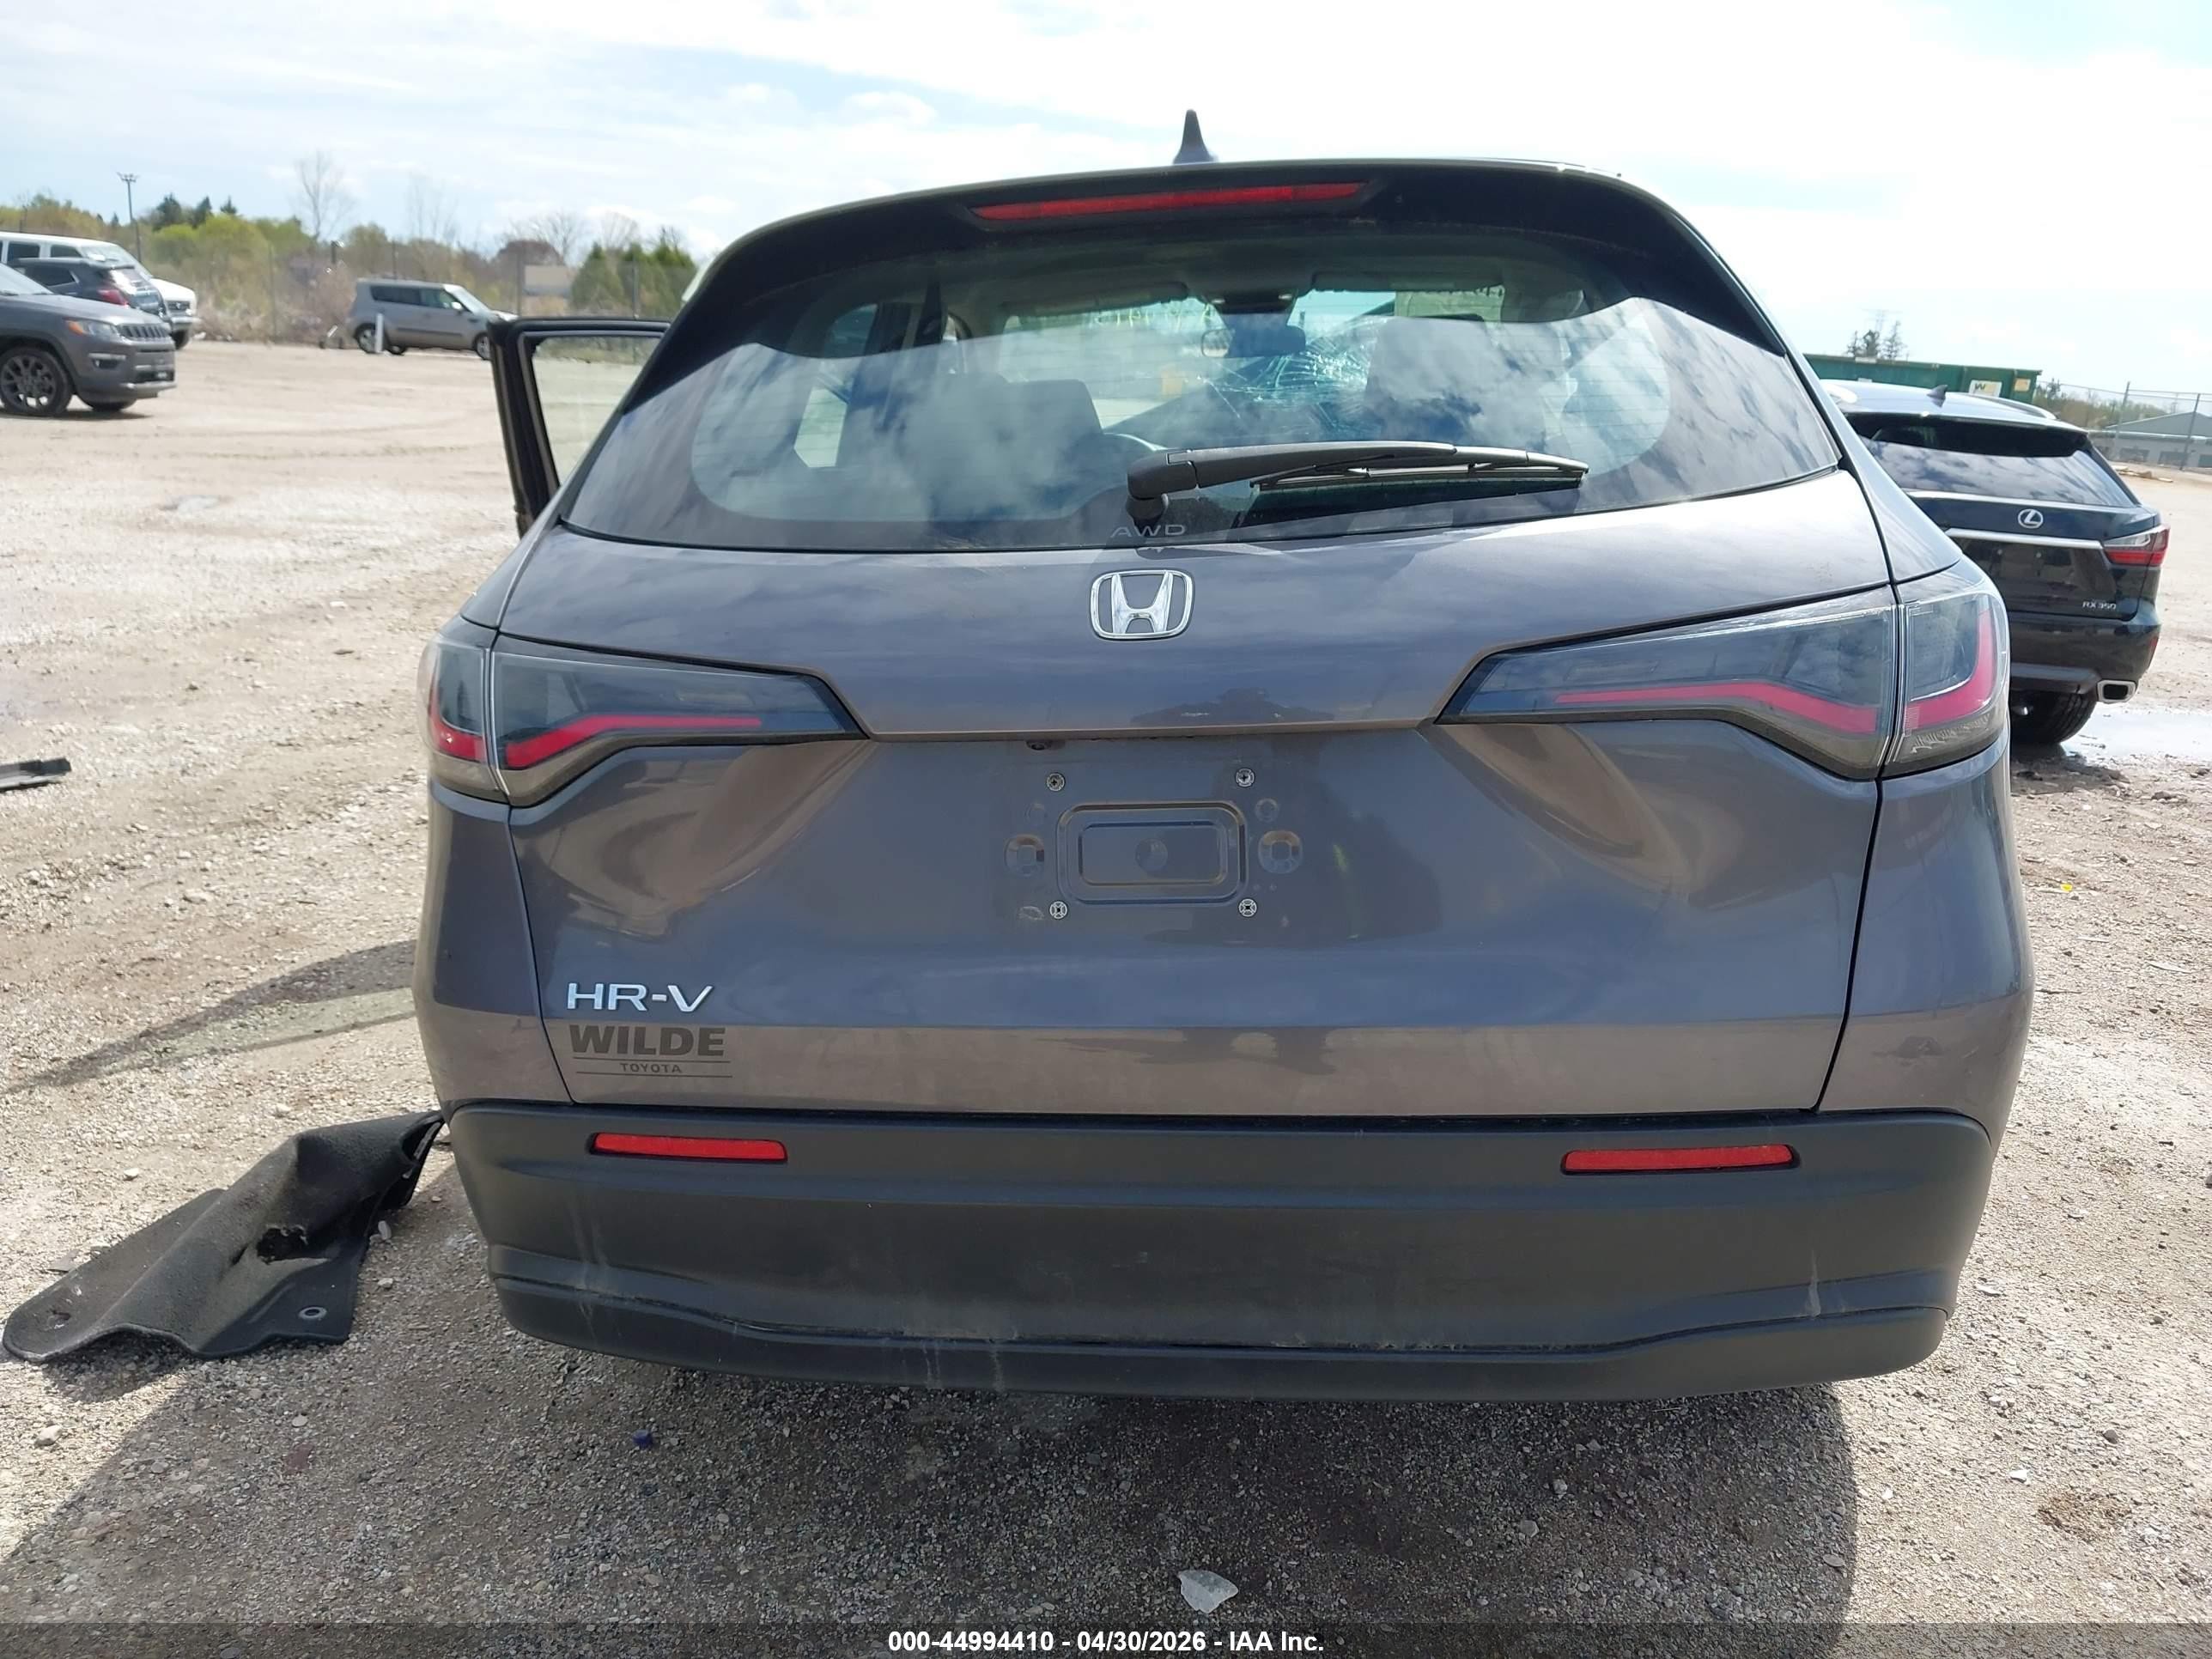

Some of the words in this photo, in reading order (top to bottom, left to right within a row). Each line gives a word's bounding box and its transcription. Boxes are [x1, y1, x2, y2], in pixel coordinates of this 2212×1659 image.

[1109, 524, 1187, 538] AWD
[2081, 600, 2097, 609] RX
[2098, 601, 2118, 611] 350
[567, 982, 714, 1012] HR-V
[568, 1024, 726, 1057] WILDE
[620, 1063, 683, 1074] TOYOTA
